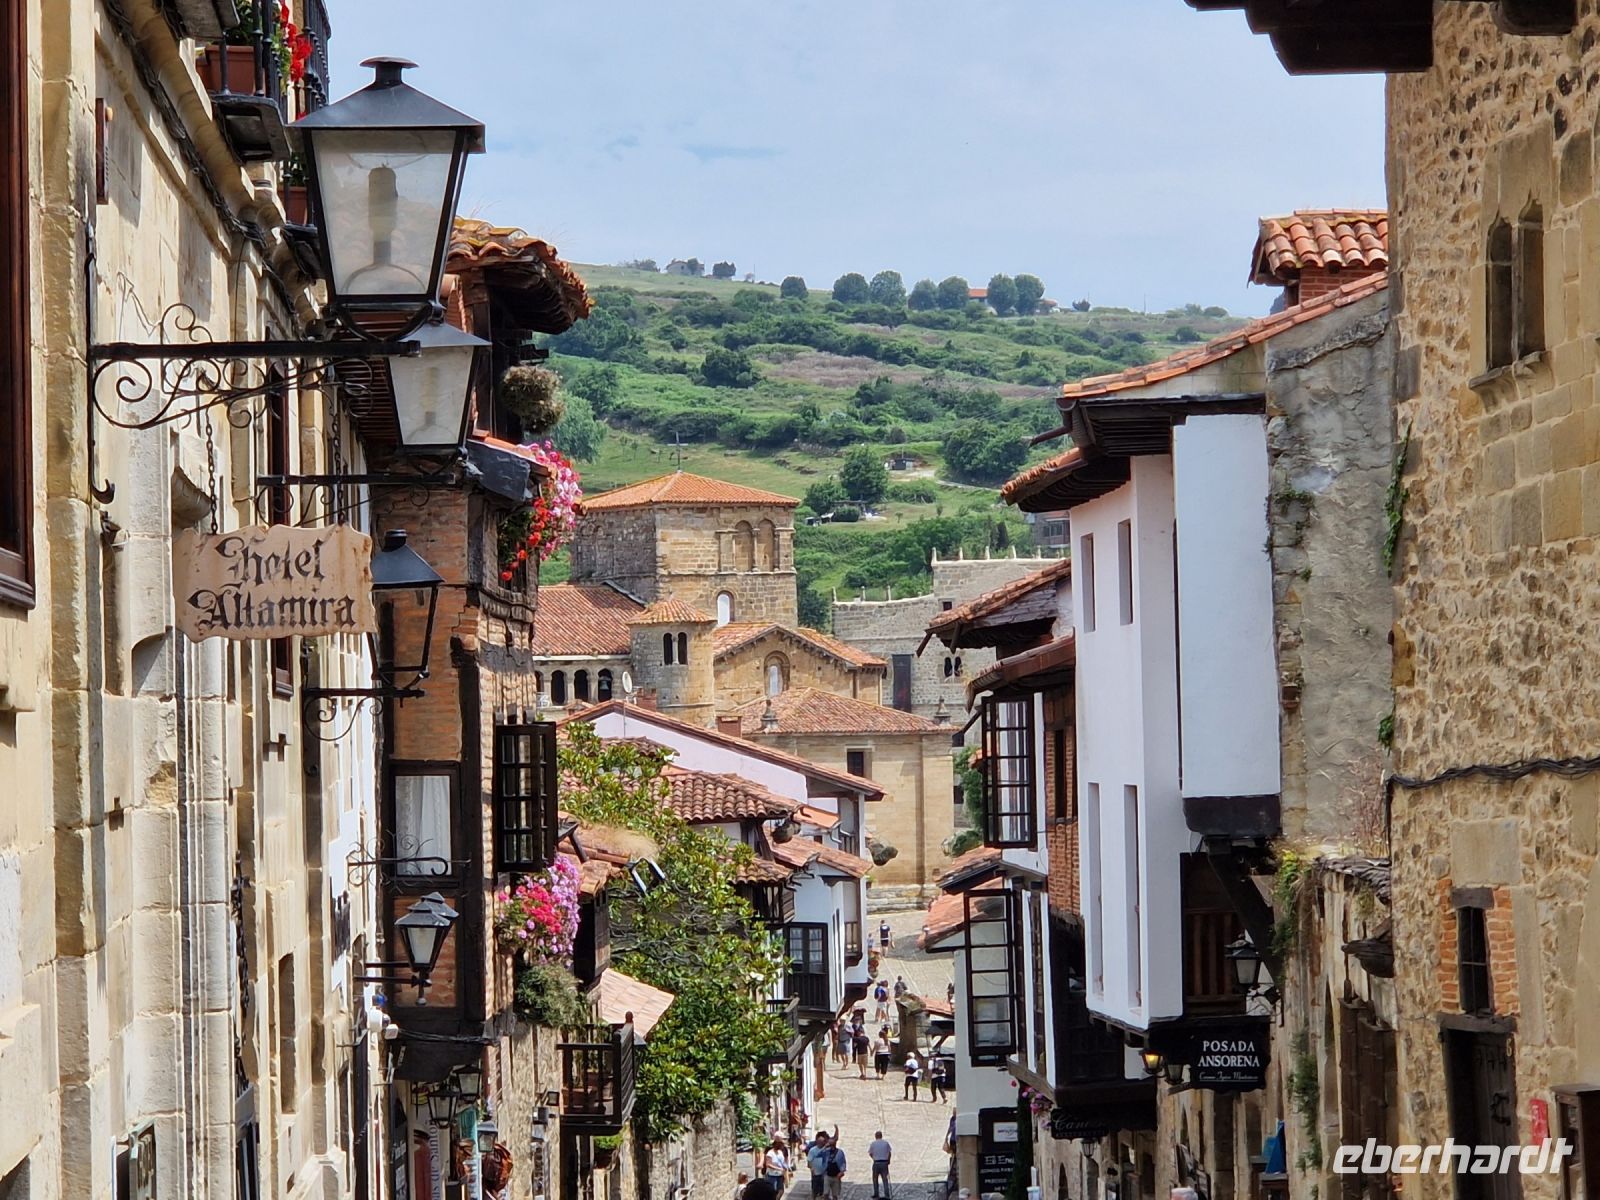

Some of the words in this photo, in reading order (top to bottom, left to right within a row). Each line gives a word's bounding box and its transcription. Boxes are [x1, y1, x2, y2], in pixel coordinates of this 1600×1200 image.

[186, 582, 357, 630] Altamira
[1202, 1040, 1256, 1052] POSADA
[1197, 1055, 1261, 1068] ANSORENA
